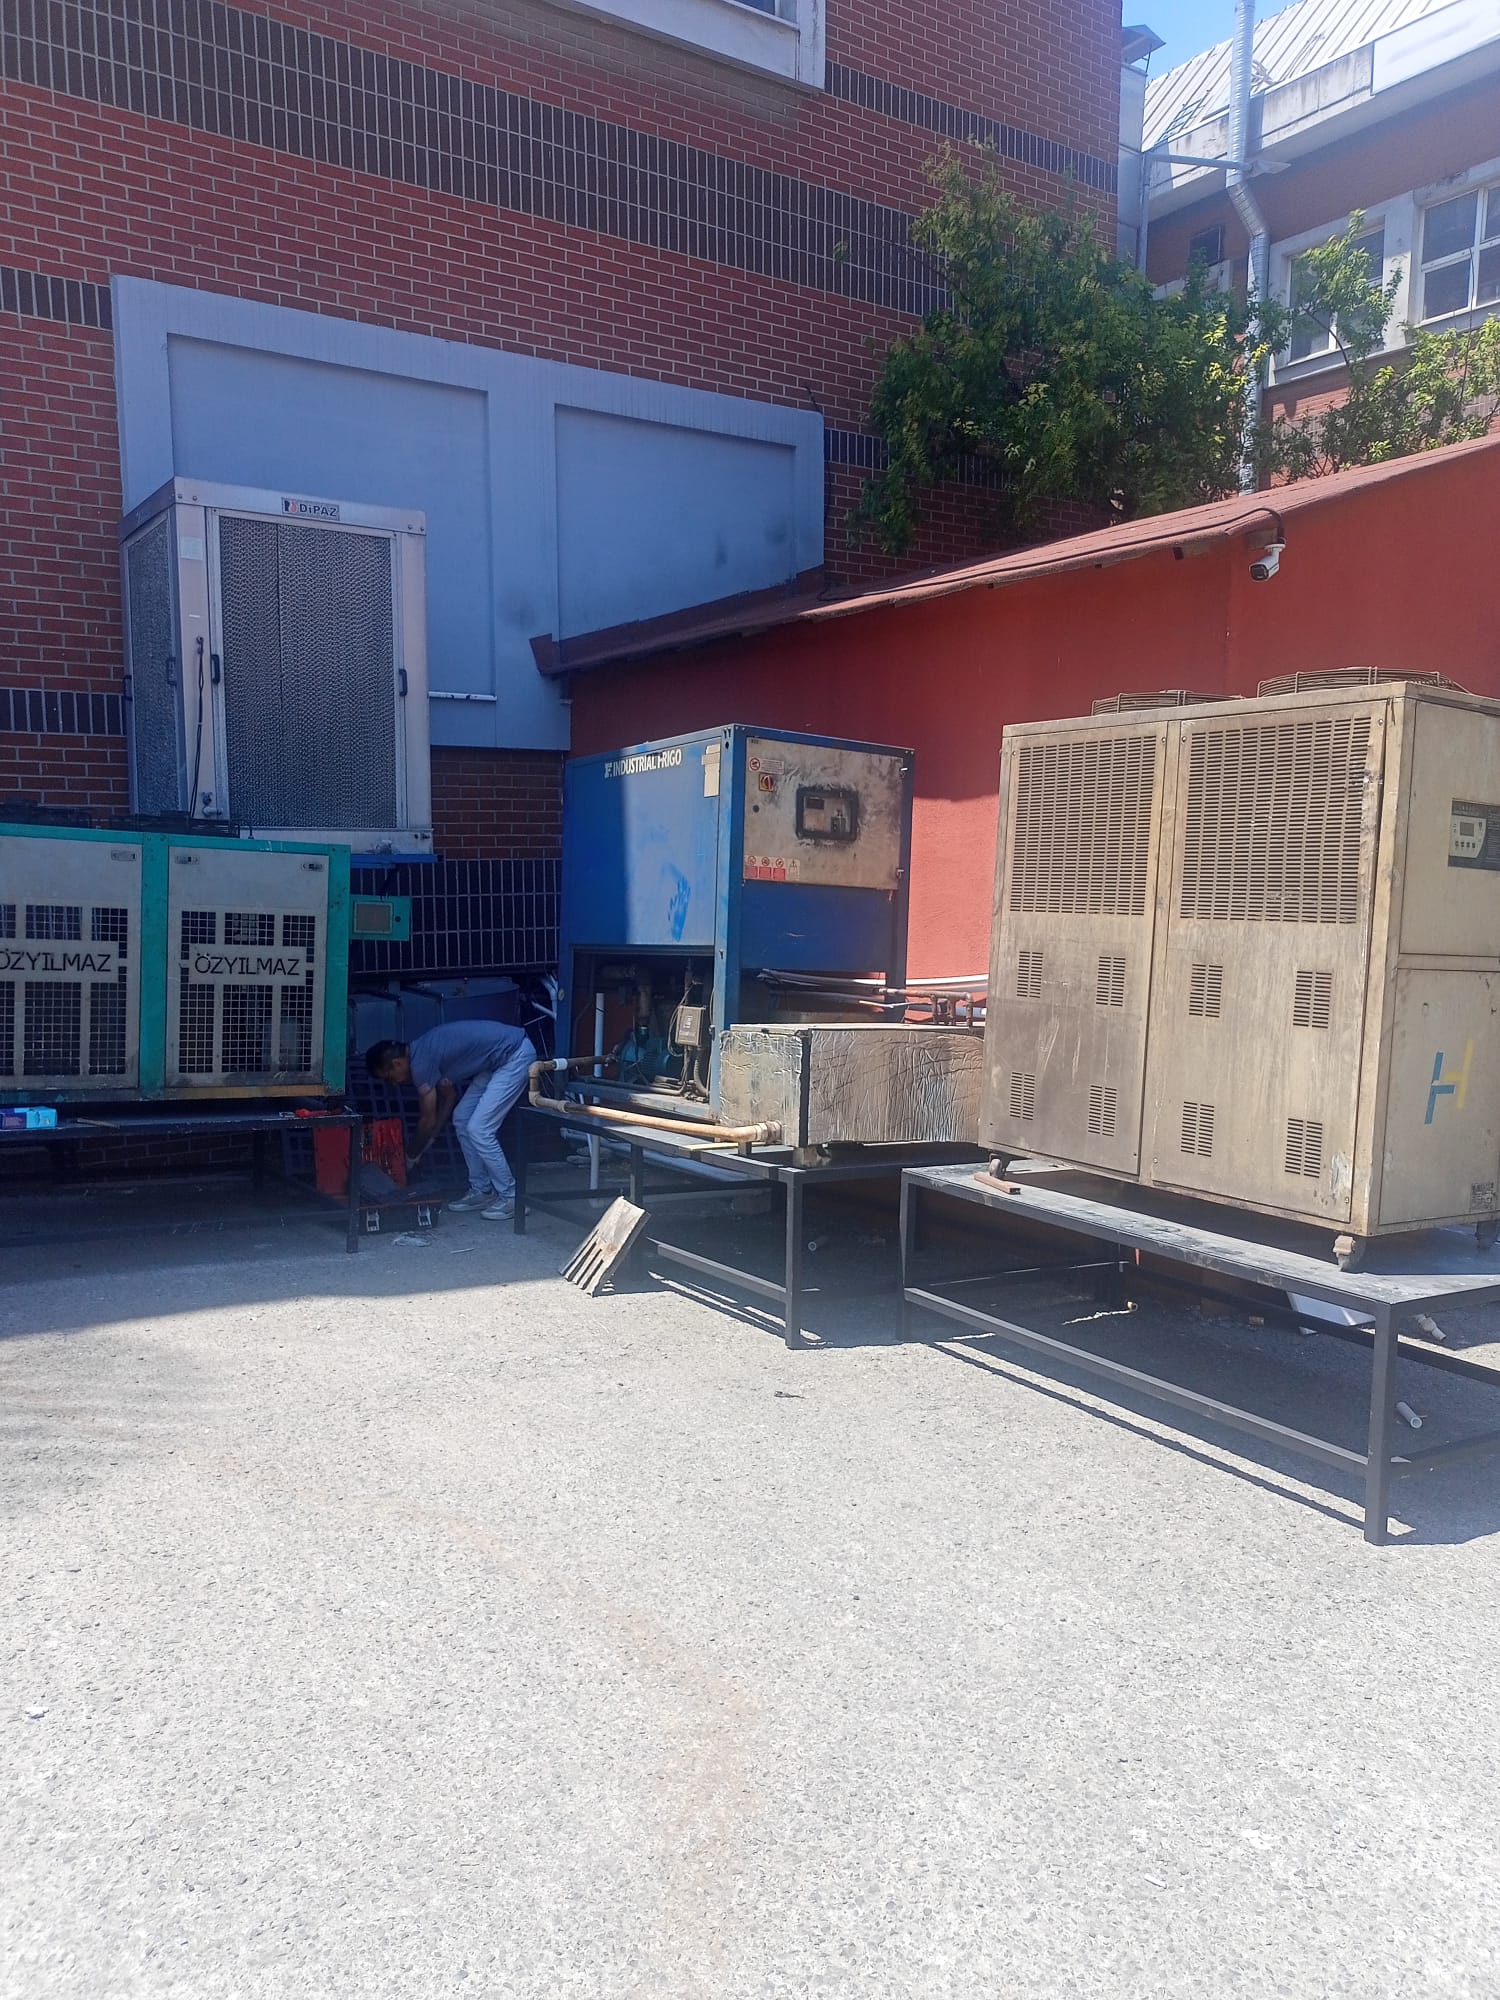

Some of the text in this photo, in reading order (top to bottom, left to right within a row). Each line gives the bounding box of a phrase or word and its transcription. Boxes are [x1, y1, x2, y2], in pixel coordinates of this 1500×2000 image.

[299, 503, 337, 517] DiPAZ
[612, 754, 657, 777] INDUSTRIAL
[195, 953, 300, 976] ÖZYILMAZ
